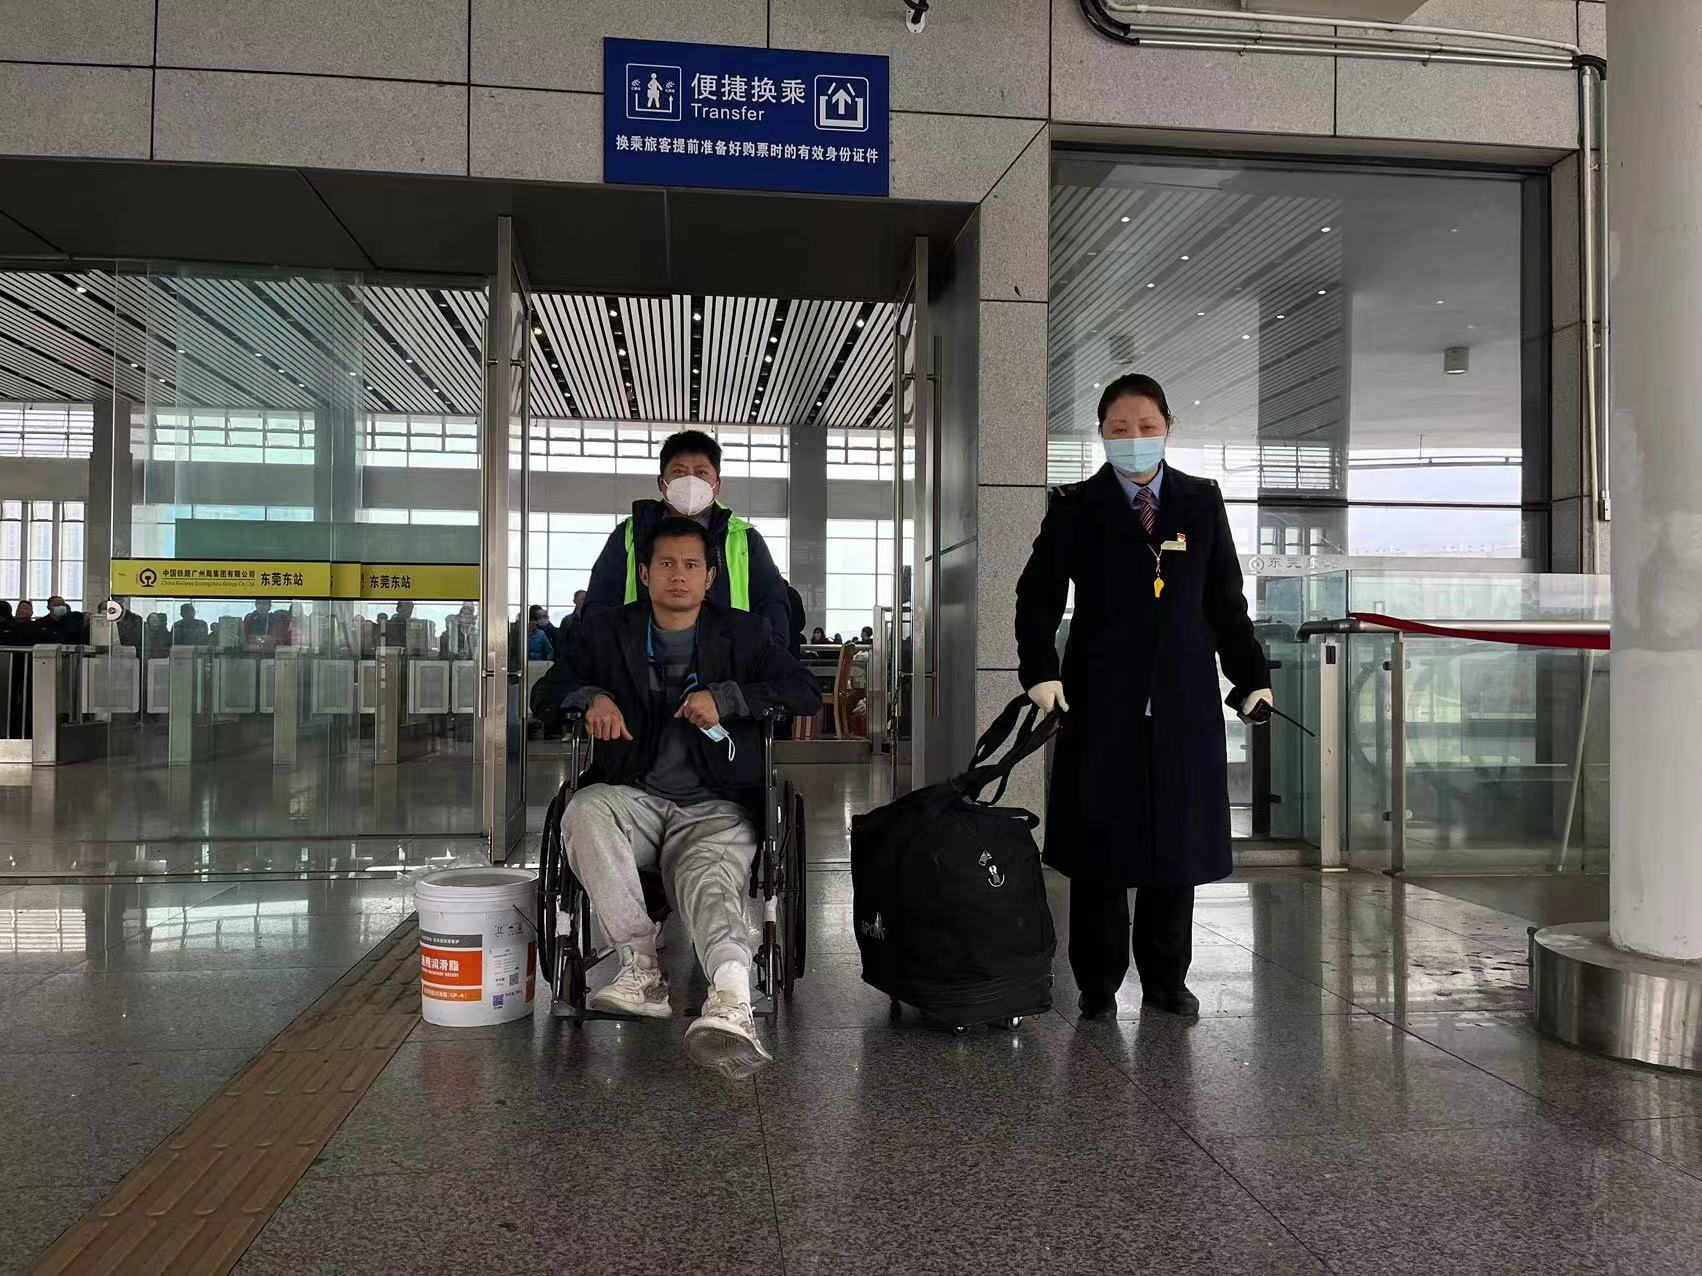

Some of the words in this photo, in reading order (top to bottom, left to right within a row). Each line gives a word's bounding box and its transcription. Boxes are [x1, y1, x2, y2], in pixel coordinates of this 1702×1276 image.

[690, 72, 806, 105] 便捷换乘
[690, 103, 765, 121] Transfer
[615, 134, 879, 164] 换乘旅客提前准备好购票时的有效身份证件
[260, 571, 304, 587] 东莞东站
[369, 574, 412, 589] 东莞东站
